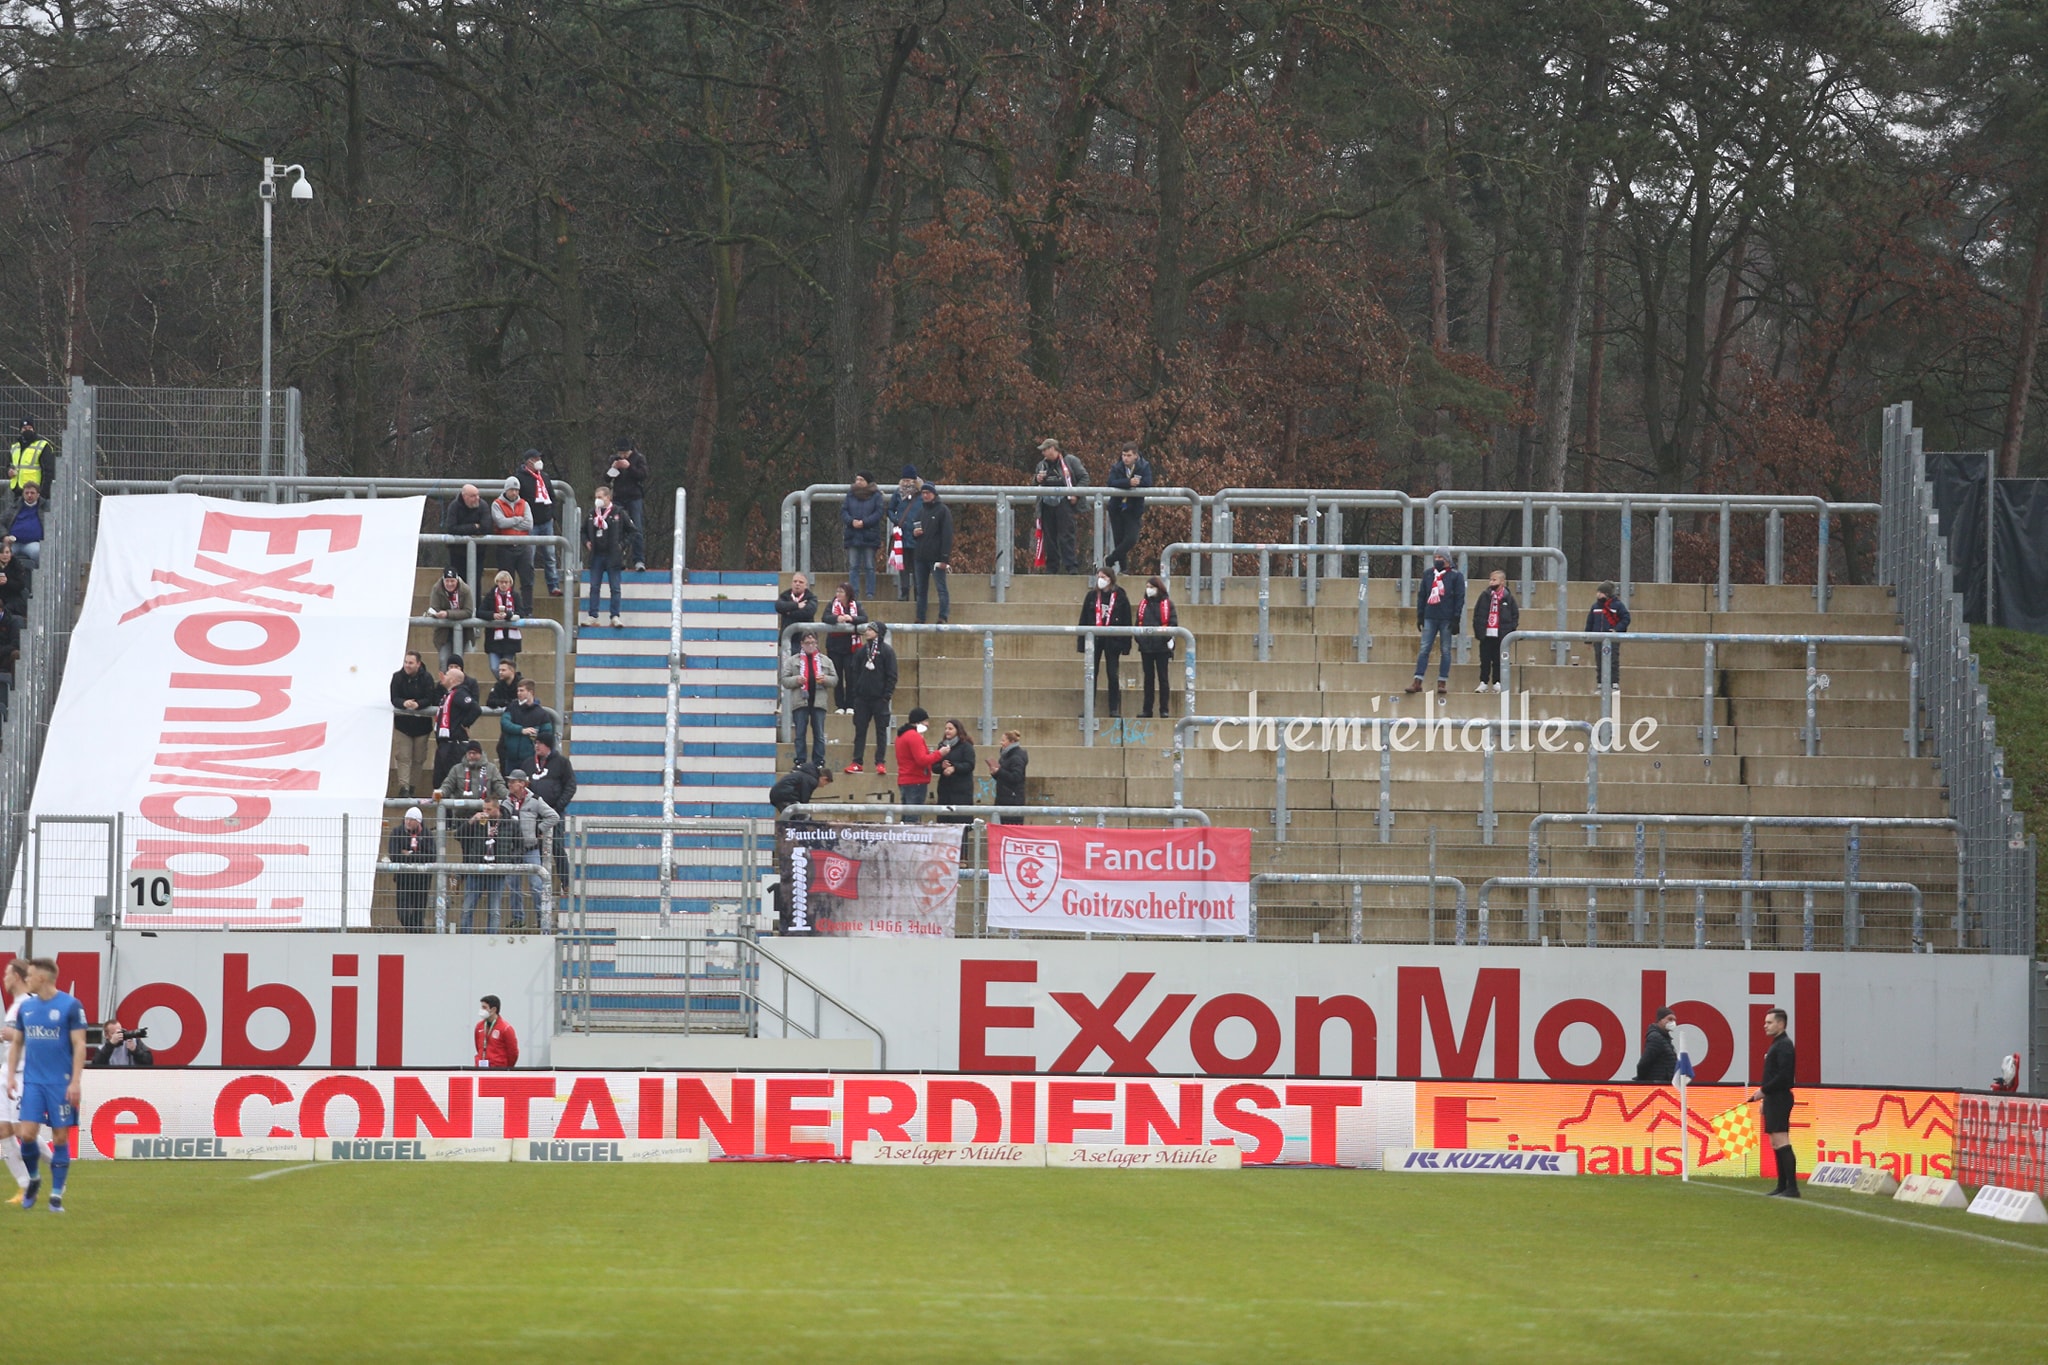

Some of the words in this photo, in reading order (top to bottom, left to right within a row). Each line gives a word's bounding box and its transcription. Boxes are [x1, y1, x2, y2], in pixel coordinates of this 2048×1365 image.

[117, 511, 363, 924] ExxonMobil
[785, 828, 837, 841] Fanclub
[840, 828, 933, 843] Goitzschefront
[1013, 843, 1045, 856] HFC
[1085, 842, 1216, 870] Fanclub
[130, 876, 170, 907] 10
[1062, 889, 1236, 920] Goitzschefront
[815, 918, 863, 934] Chemie
[868, 919, 903, 934] 1966
[908, 919, 944, 935] Halle
[958, 957, 1821, 1084] ExxonMobil
[59, 1104, 72, 1116] 18
[212, 1074, 1364, 1167] CONTAINERDIENST
[131, 1137, 227, 1158] NÖGEL
[332, 1138, 426, 1160] NÖGEL
[529, 1139, 623, 1162] NÖGEL
[874, 1145, 957, 1164] Aselager
[961, 1145, 1023, 1161] Mühle
[1070, 1147, 1151, 1168] Aselager
[1155, 1147, 1217, 1165] Mühle
[1443, 1153, 1523, 1170] KUZKA
